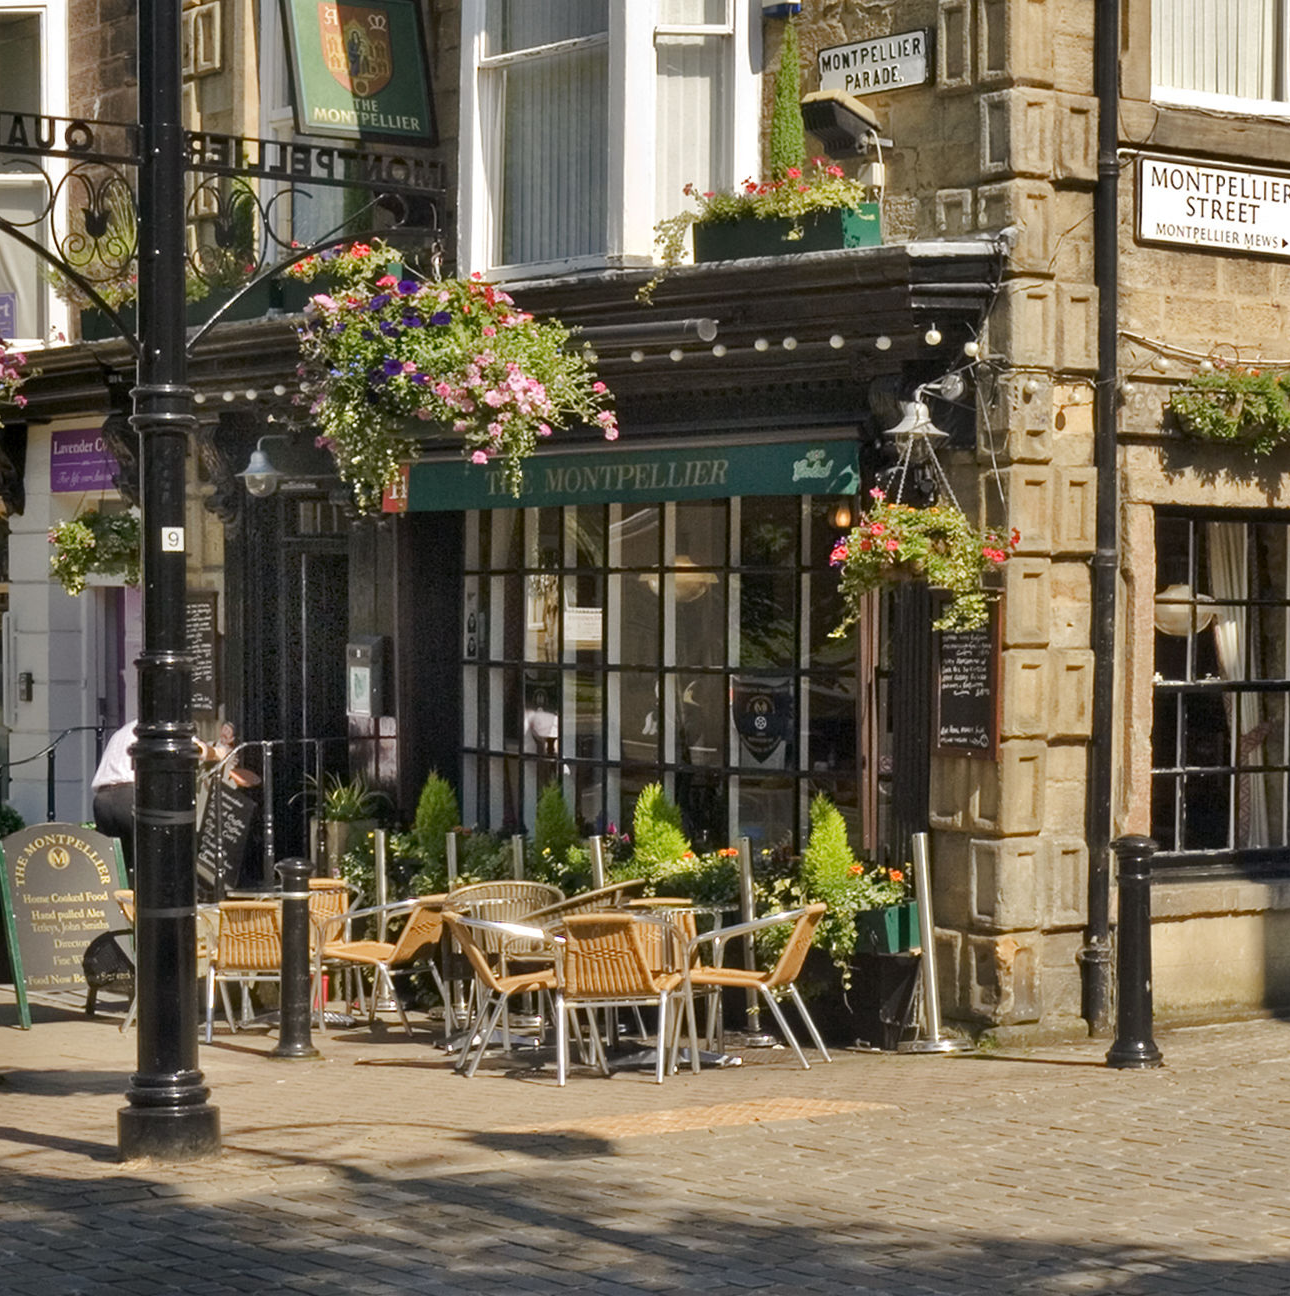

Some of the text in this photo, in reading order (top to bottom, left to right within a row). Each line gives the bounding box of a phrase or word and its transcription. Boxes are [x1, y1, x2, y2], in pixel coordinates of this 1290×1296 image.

[821, 37, 921, 73] MONTPELLIER
[845, 65, 903, 92] PARADE.
[353, 98, 378, 112] THE
[313, 107, 421, 131] MONTPELLIER
[1186, 196, 1260, 225] STREET
[1155, 222, 1279, 248] MONTPELLIER MEWS
[53, 439, 93, 455] Lavender
[544, 459, 729, 494] MONTPELLIER
[168, 531, 179, 547] 9
[14, 834, 111, 887] THE MONTPELLIER
[23, 891, 109, 904] Home Cooked Food
[31, 908, 105, 921] Hand pulled Ales
[61, 921, 81, 934] John
[82, 920, 109, 931] Smiths
[54, 938, 91, 949] Director
[53, 955, 71, 966] Fine
[28, 975, 48, 985] Food
[50, 974, 71, 985] Now
